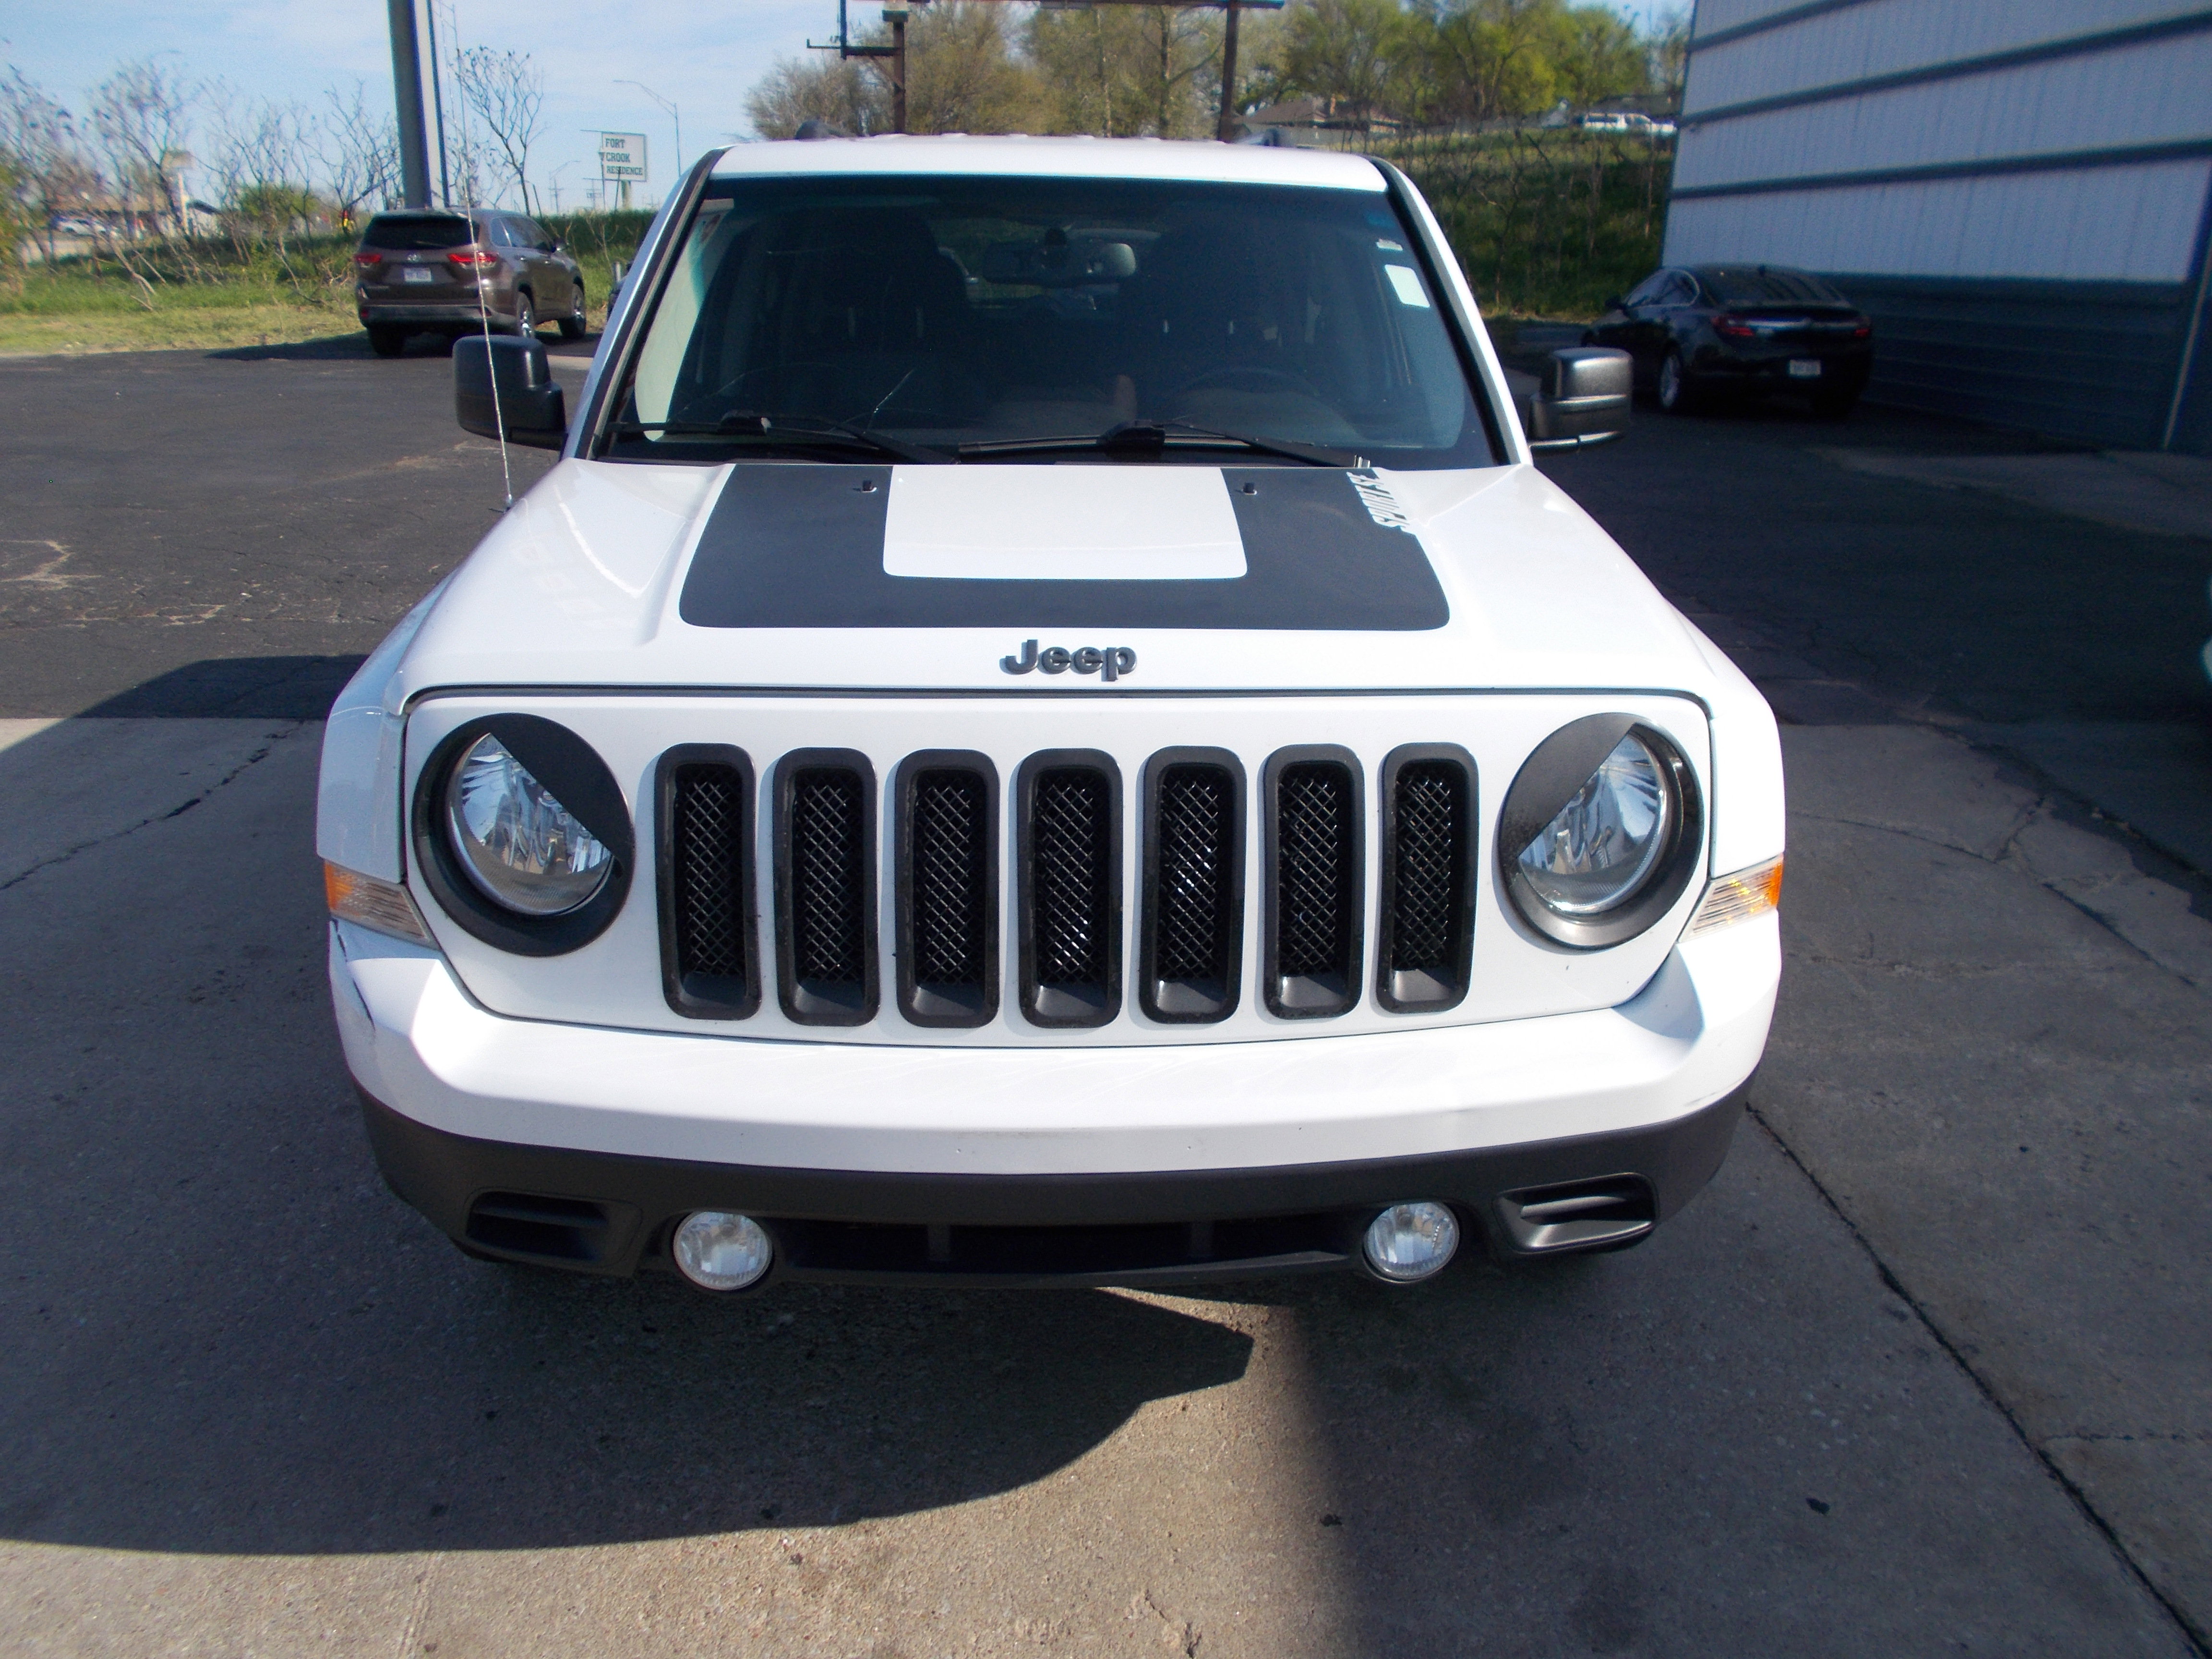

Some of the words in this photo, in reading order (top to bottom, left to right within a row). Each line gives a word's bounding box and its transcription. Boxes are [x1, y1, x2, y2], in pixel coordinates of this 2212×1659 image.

[606, 138, 625, 148] FORT
[606, 152, 630, 162] CROOK
[606, 166, 643, 175] RESIDENCE
[1002, 639, 1137, 682] Jeep
